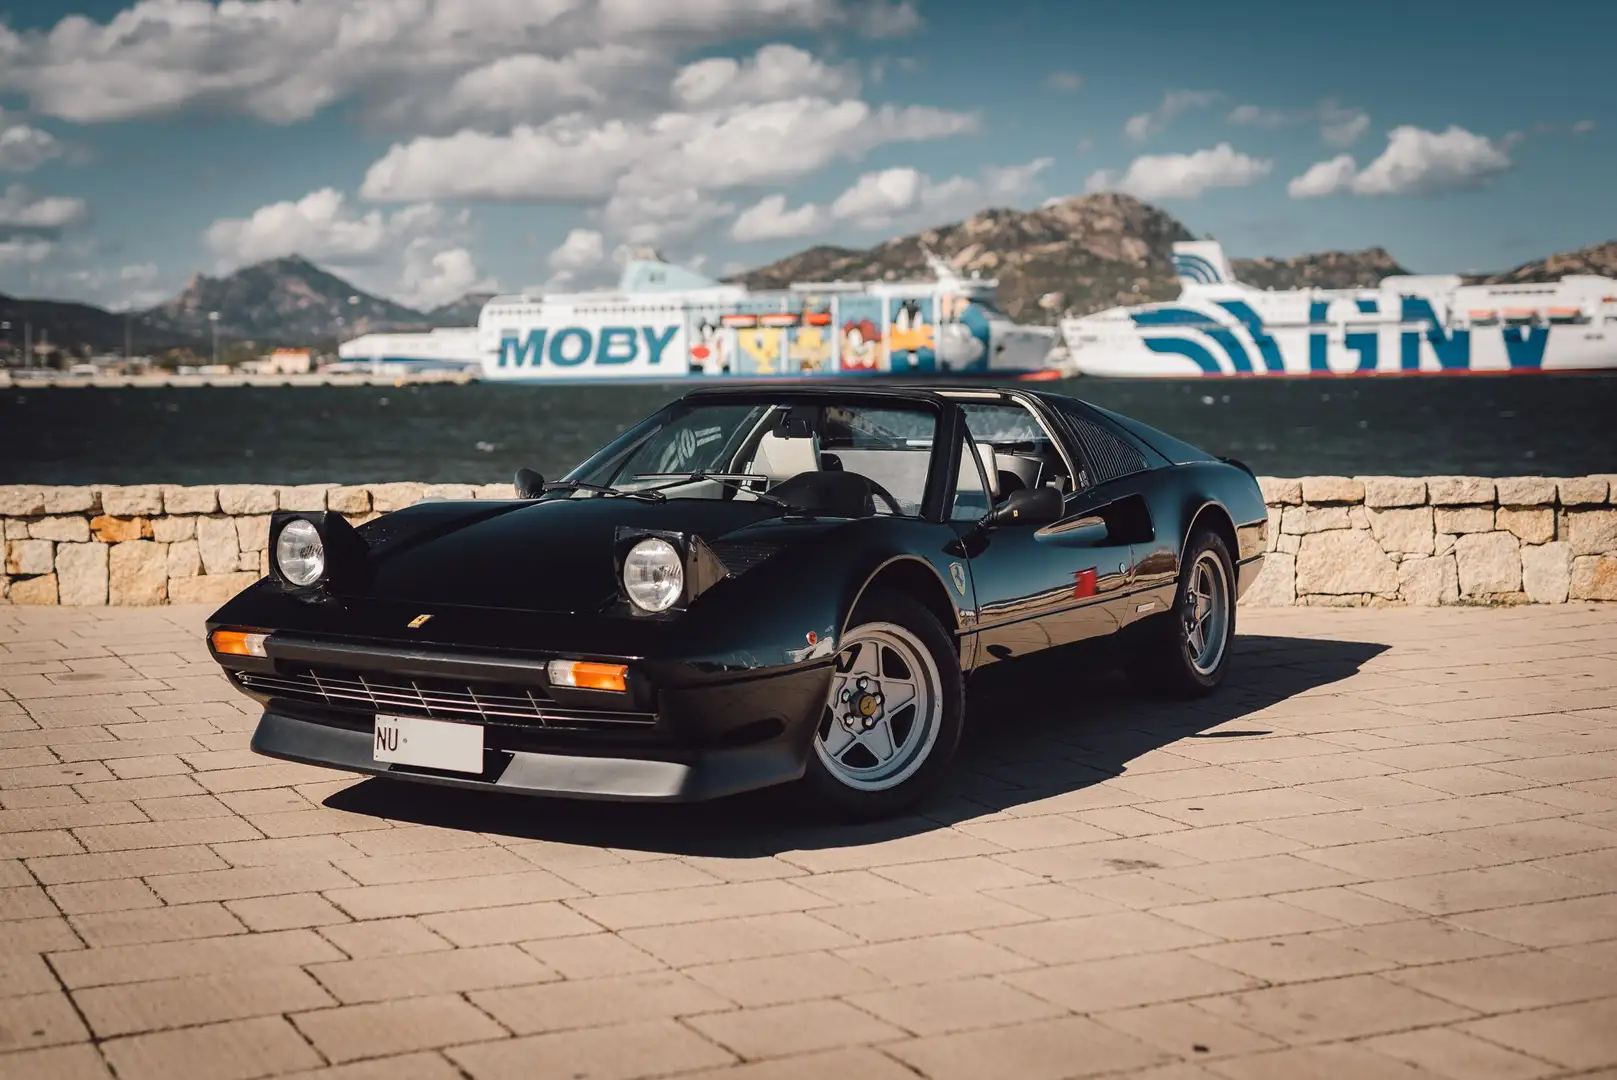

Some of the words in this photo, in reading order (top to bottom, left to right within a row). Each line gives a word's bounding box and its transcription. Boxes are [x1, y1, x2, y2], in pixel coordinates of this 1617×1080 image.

[497, 326, 680, 367] MOBY
[1309, 298, 1549, 370] GNV
[376, 726, 399, 751] NU
